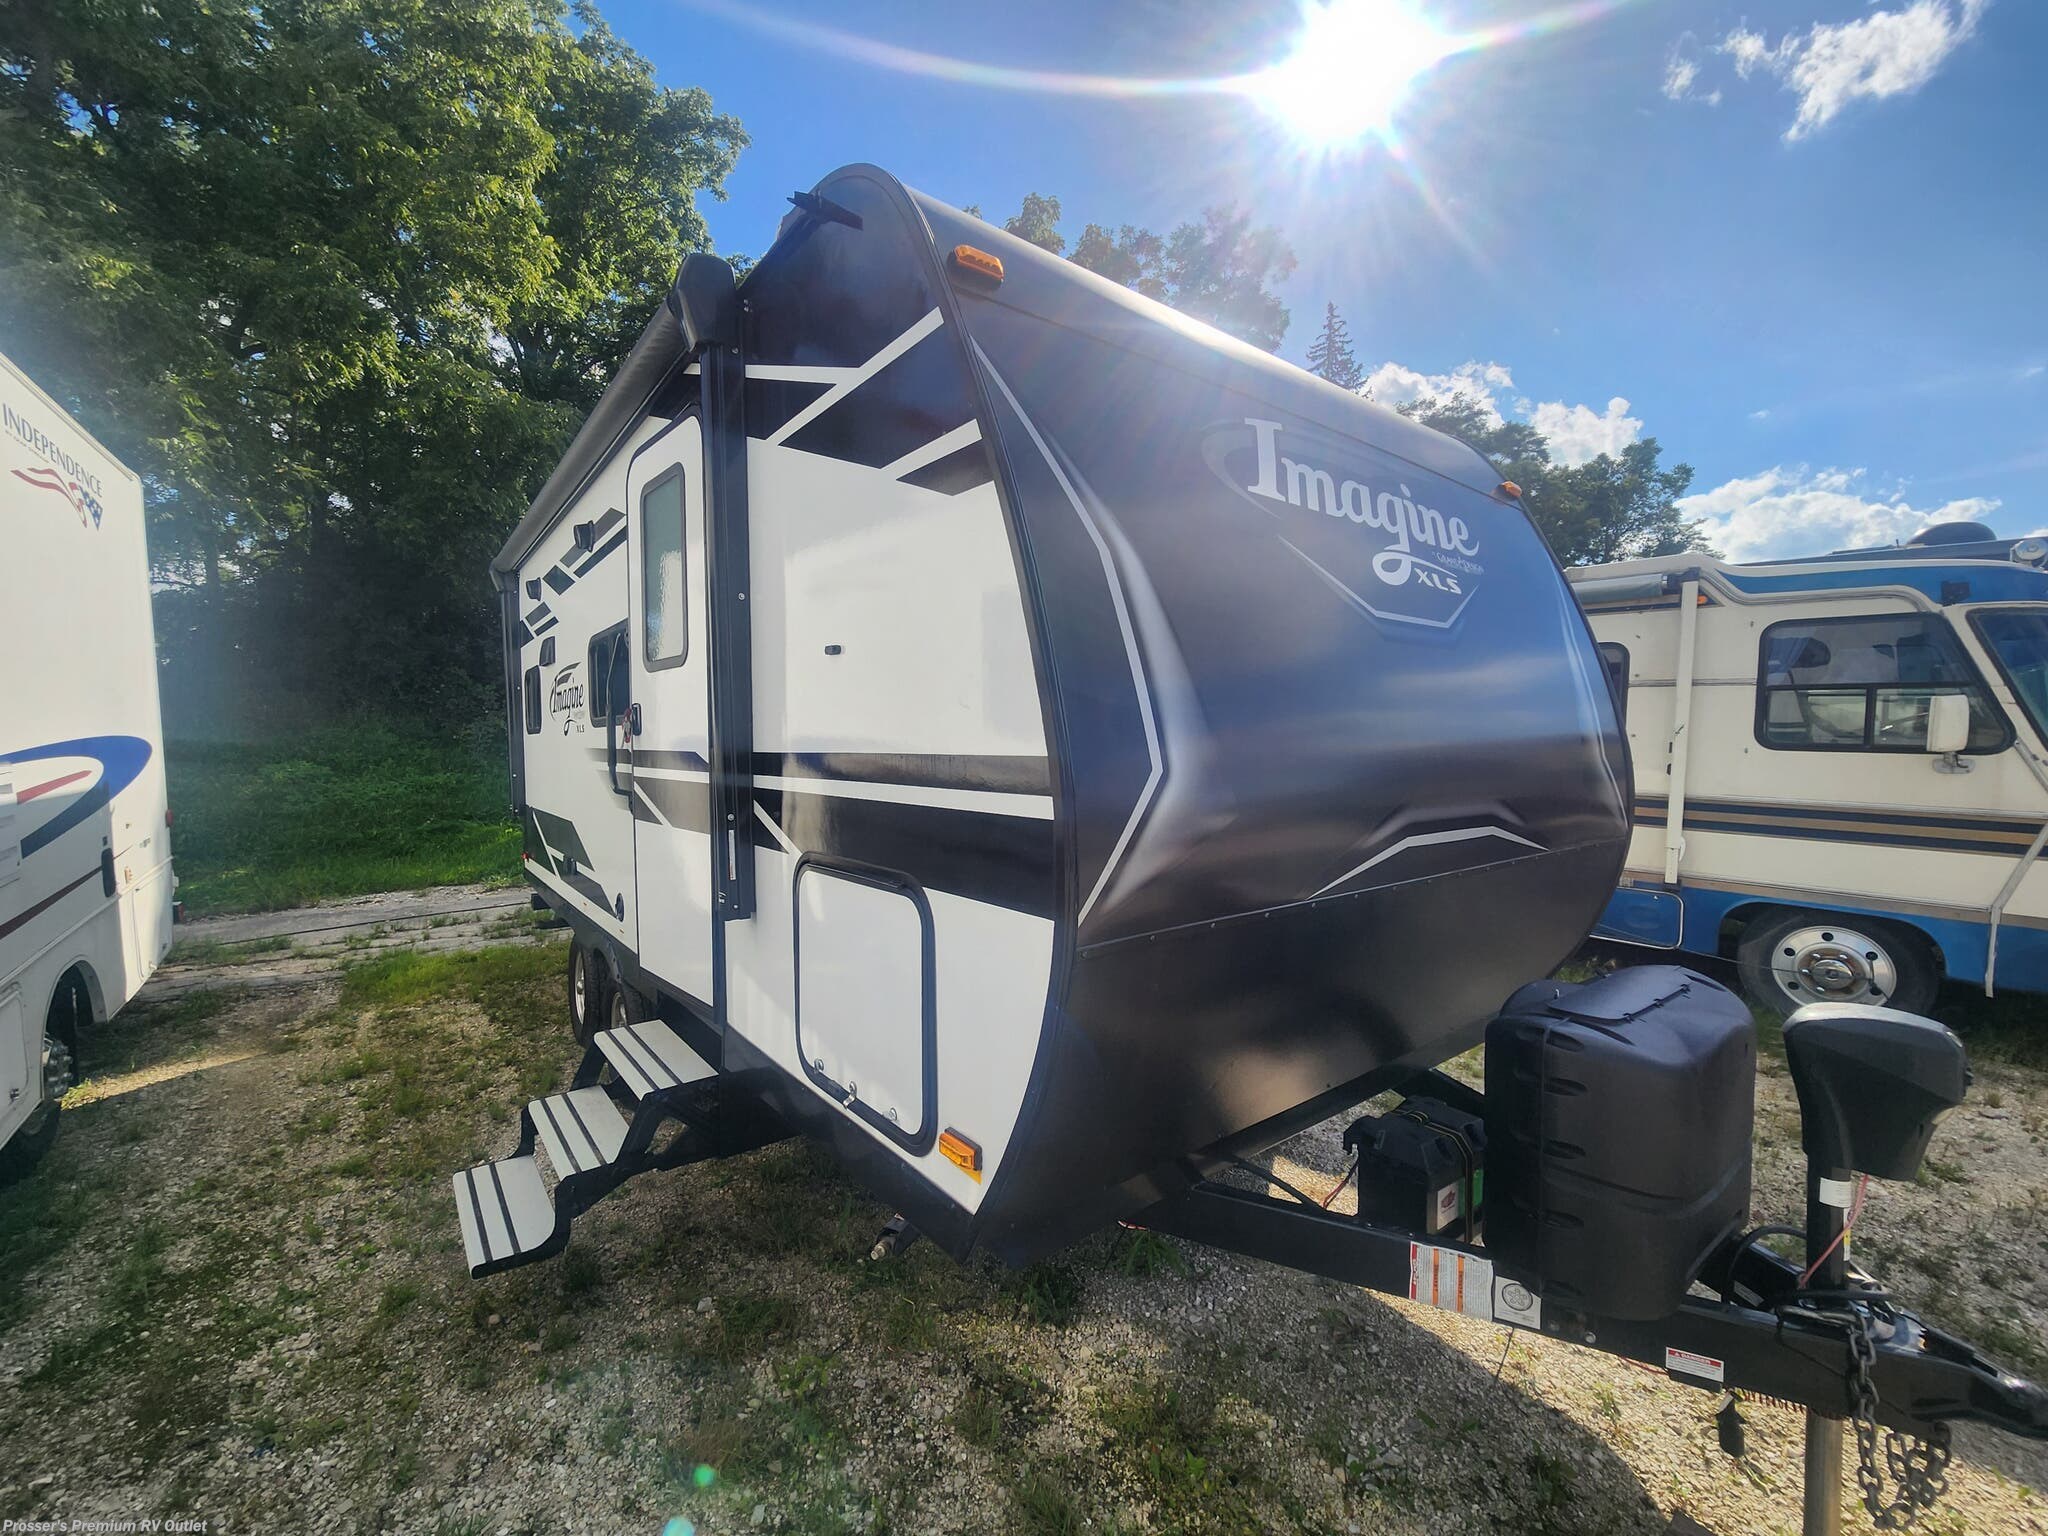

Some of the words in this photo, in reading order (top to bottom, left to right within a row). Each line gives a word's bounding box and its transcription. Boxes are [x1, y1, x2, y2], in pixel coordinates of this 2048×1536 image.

[3, 403, 103, 498] INDEPENDENCE
[1244, 417, 1480, 586] Imagine
[1413, 567, 1462, 595] XLS
[552, 675, 584, 736] Imagine
